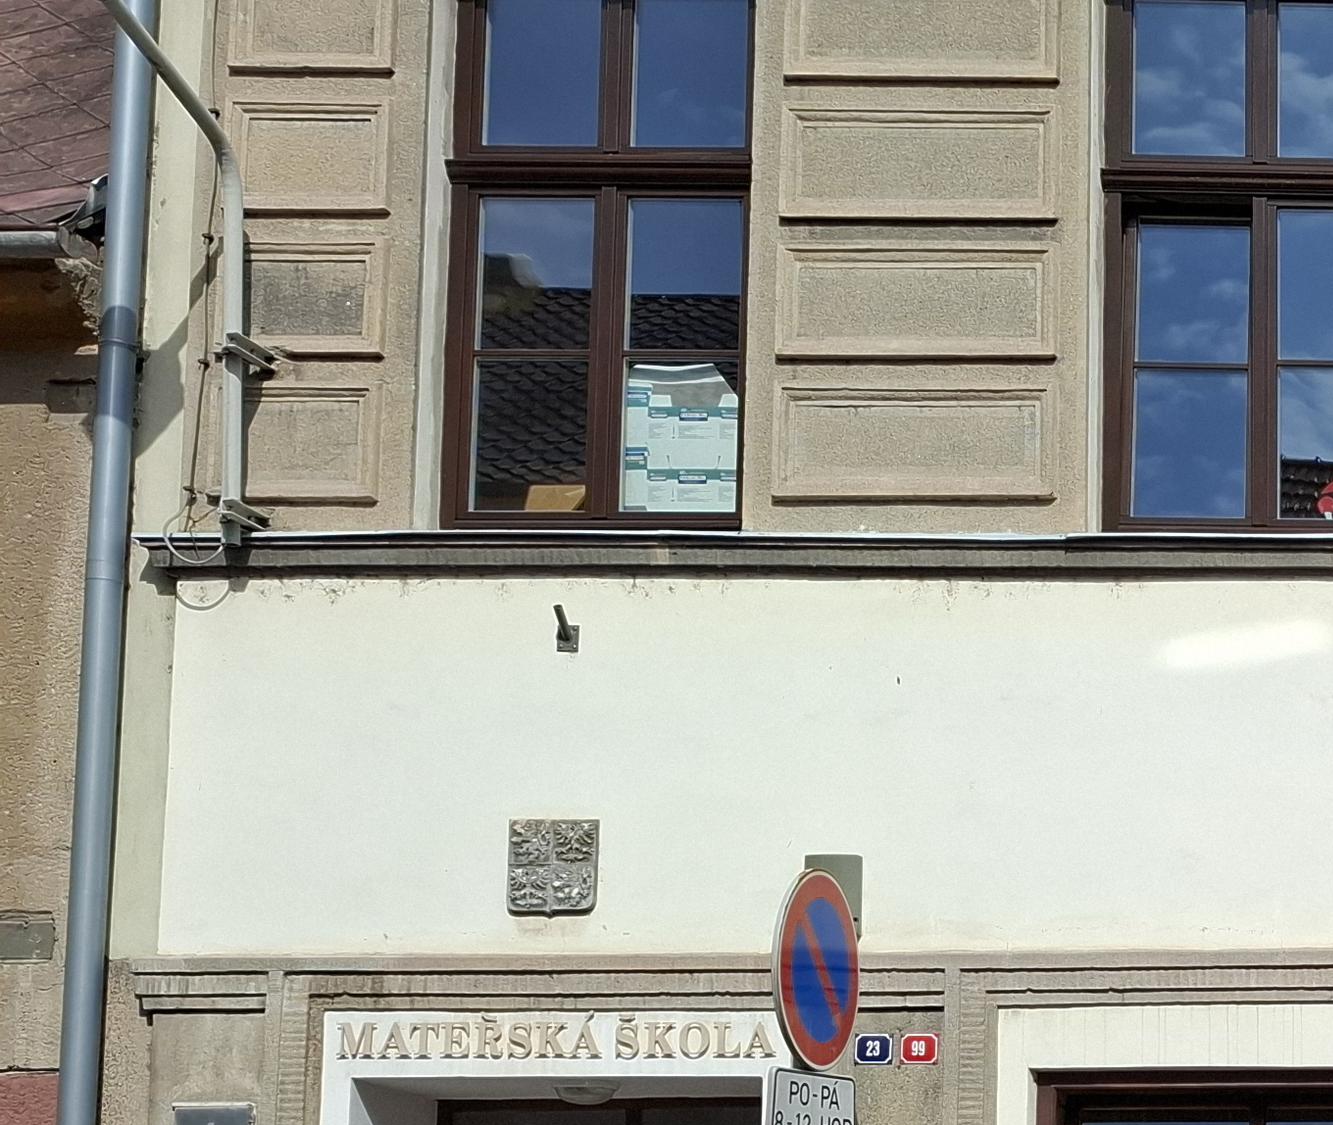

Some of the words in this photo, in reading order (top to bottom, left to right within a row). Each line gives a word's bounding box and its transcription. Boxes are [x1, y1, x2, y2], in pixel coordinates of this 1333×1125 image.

[336, 1011, 602, 1060] MATEŘSKÁ
[614, 1013, 777, 1060] ŠKOLA
[865, 1040, 881, 1057] 23
[911, 1040, 926, 1057] 99
